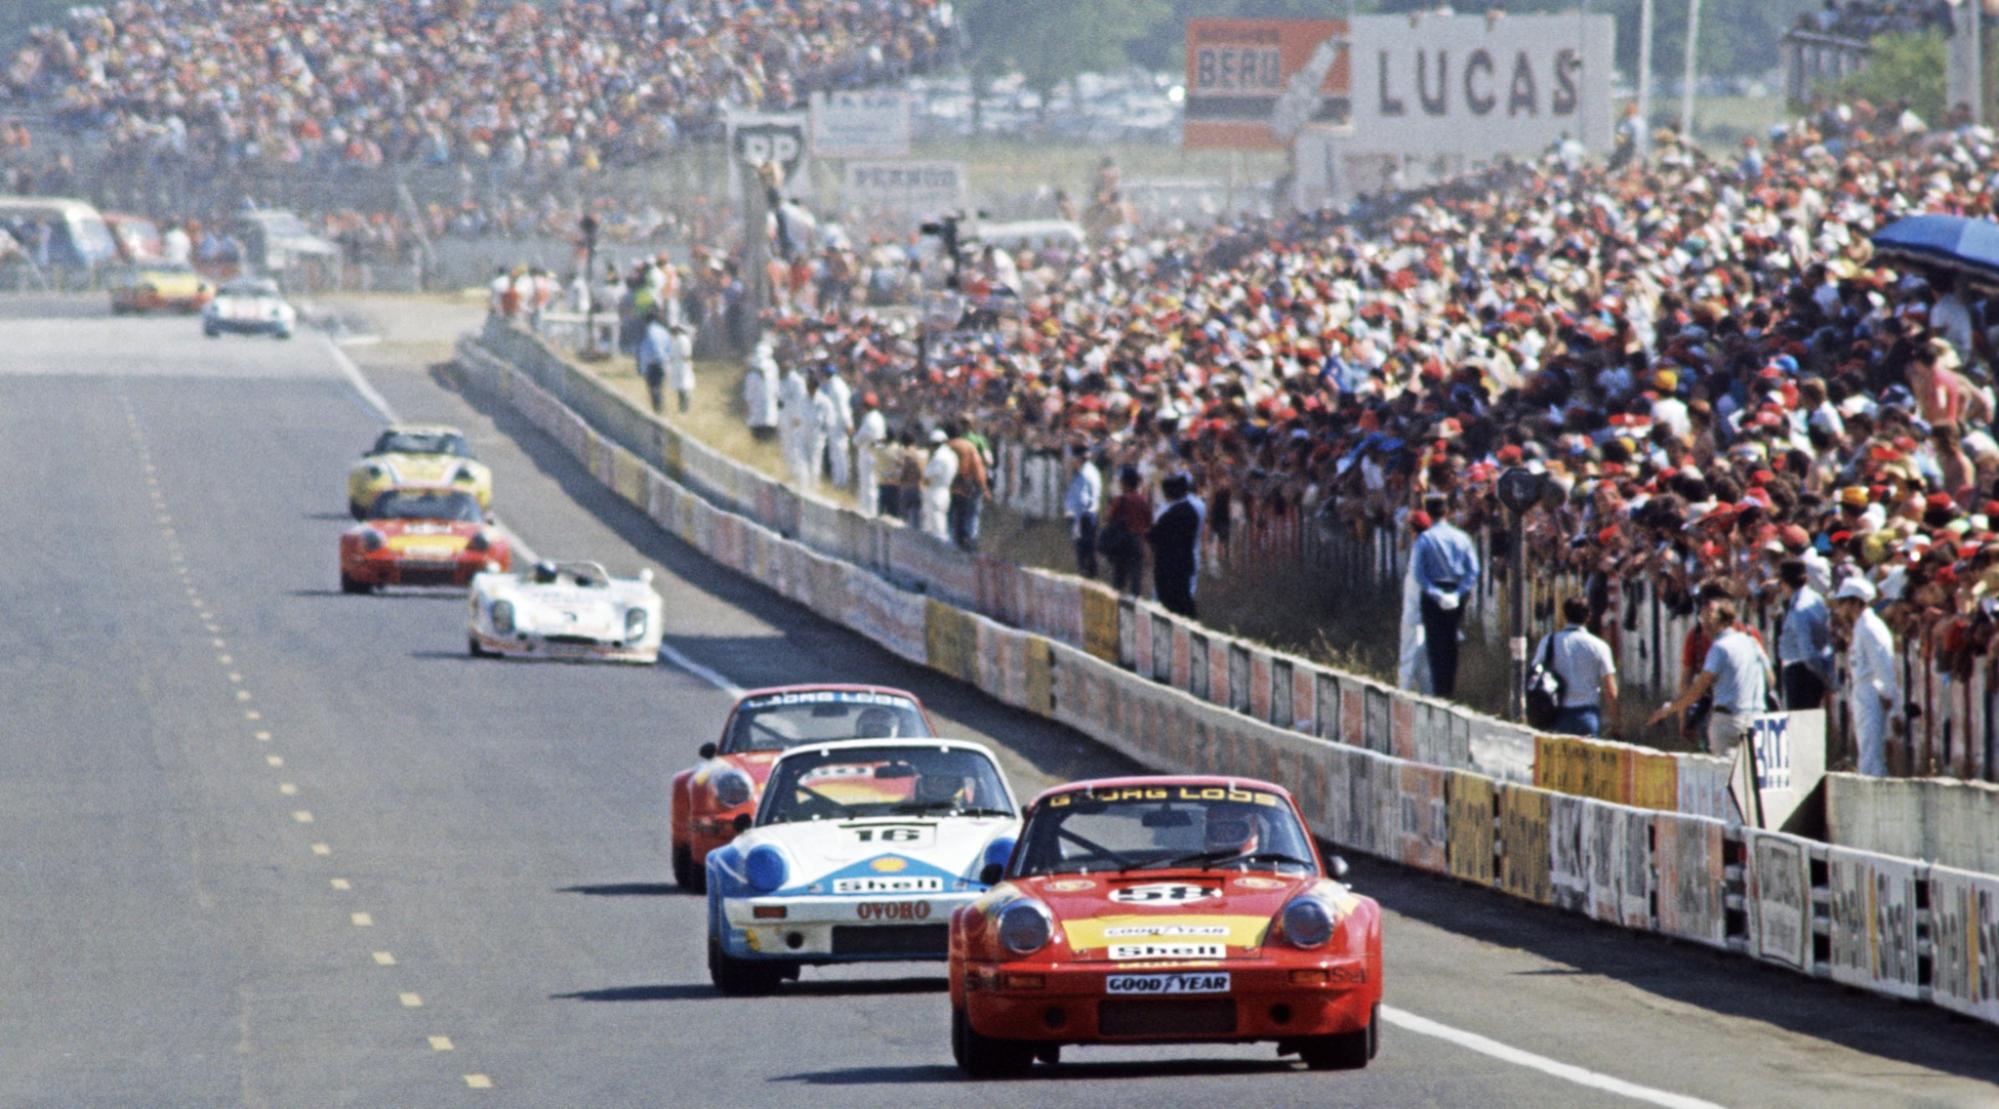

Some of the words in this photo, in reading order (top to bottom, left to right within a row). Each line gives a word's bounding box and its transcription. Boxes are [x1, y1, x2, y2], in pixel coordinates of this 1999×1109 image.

[1198, 49, 1280, 88] BERU
[1378, 48, 1578, 117] LUCAS
[1179, 787, 1277, 807] LOOS
[855, 830, 920, 842] 16
[840, 880, 938, 891] Shell
[1118, 887, 1215, 901] 58
[1117, 946, 1217, 957] Shell
[1109, 978, 1162, 991] GOOD
[1178, 976, 1228, 990] YEAR
